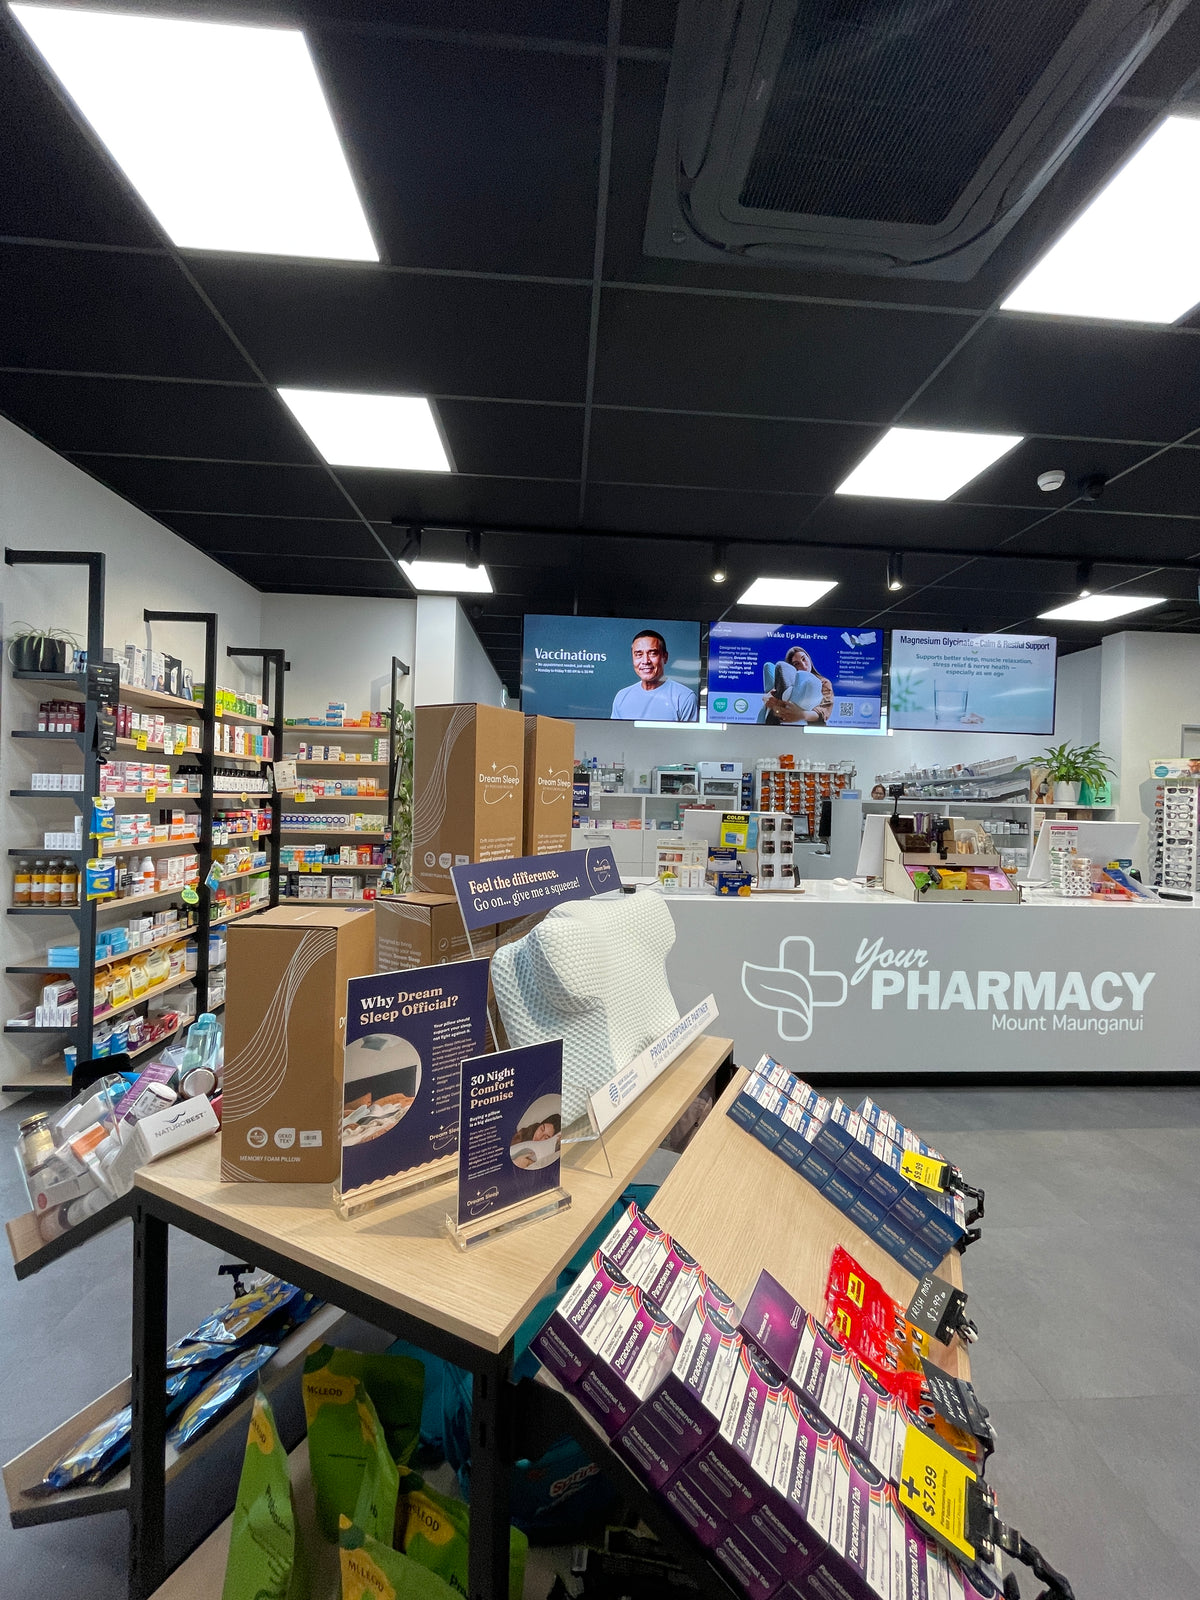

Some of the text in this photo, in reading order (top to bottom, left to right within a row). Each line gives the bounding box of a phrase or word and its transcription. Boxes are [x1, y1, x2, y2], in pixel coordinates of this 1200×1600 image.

[534, 647, 607, 662] Vaccinations
[766, 631, 828, 640] Wake Up Pain-Free
[900, 635, 941, 646] Magnesium
[1025, 641, 1050, 651] Support
[916, 653, 943, 661] Supports
[962, 655, 979, 663] sleep,
[479, 773, 520, 786] Dream Sleep
[537, 777, 571, 789] Dream Sleep
[468, 869, 560, 895] Feel the difference.
[473, 876, 581, 912] Go on... give me a squeeze!
[850, 936, 929, 986] Your
[359, 995, 459, 1026] Sleep Official?
[360, 987, 443, 1010] Why Dream
[871, 970, 1156, 1012] PHARMACY
[649, 1002, 708, 1060] PROUD CORPORATE PARTNER
[991, 1013, 1144, 1036] Mount Maunganui
[470, 1074, 485, 1086] 30
[486, 1067, 515, 1083] Night
[470, 1078, 515, 1098] Comfort
[469, 1114, 484, 1122] Buying
[470, 1090, 514, 1109] Promise
[154, 1112, 205, 1138] NATUROBEST
[429, 1126, 460, 1141] Dream Slee
[466, 1190, 500, 1207] Dream Sleep
[612, 1227, 639, 1263] Paracetamol Tab
[651, 1260, 675, 1299] Paracetamol Tab
[910, 1277, 933, 1320] IRISH MOSS
[571, 1280, 603, 1325] Paracetamol Tab
[547, 1326, 582, 1368] Paracetamol Tab
[614, 1319, 644, 1369] Paracetamol Tab
[688, 1333, 712, 1387] Paracetamol Tab
[806, 1347, 824, 1395] Paracetamol Tab
[590, 1370, 626, 1414] Paracetamol Tab
[661, 1389, 703, 1436] Paracetamol Tab
[736, 1386, 759, 1449] Paracetamol Tab
[855, 1393, 870, 1446] Paracetamol Tab
[629, 1425, 669, 1472] Paracetamol Tab
[790, 1434, 809, 1503] Paracetamol Tab
[707, 1450, 752, 1499] Paracetamol Tab
[922, 1465, 937, 1517] $7.99
[675, 1480, 717, 1529] Paracetamol Tab
[849, 1486, 861, 1563] Paracetamol Tab
[761, 1504, 809, 1556] Paracetamol Tab
[909, 1538, 918, 1556] Tab
[725, 1537, 770, 1589] Paracetamol Tab
